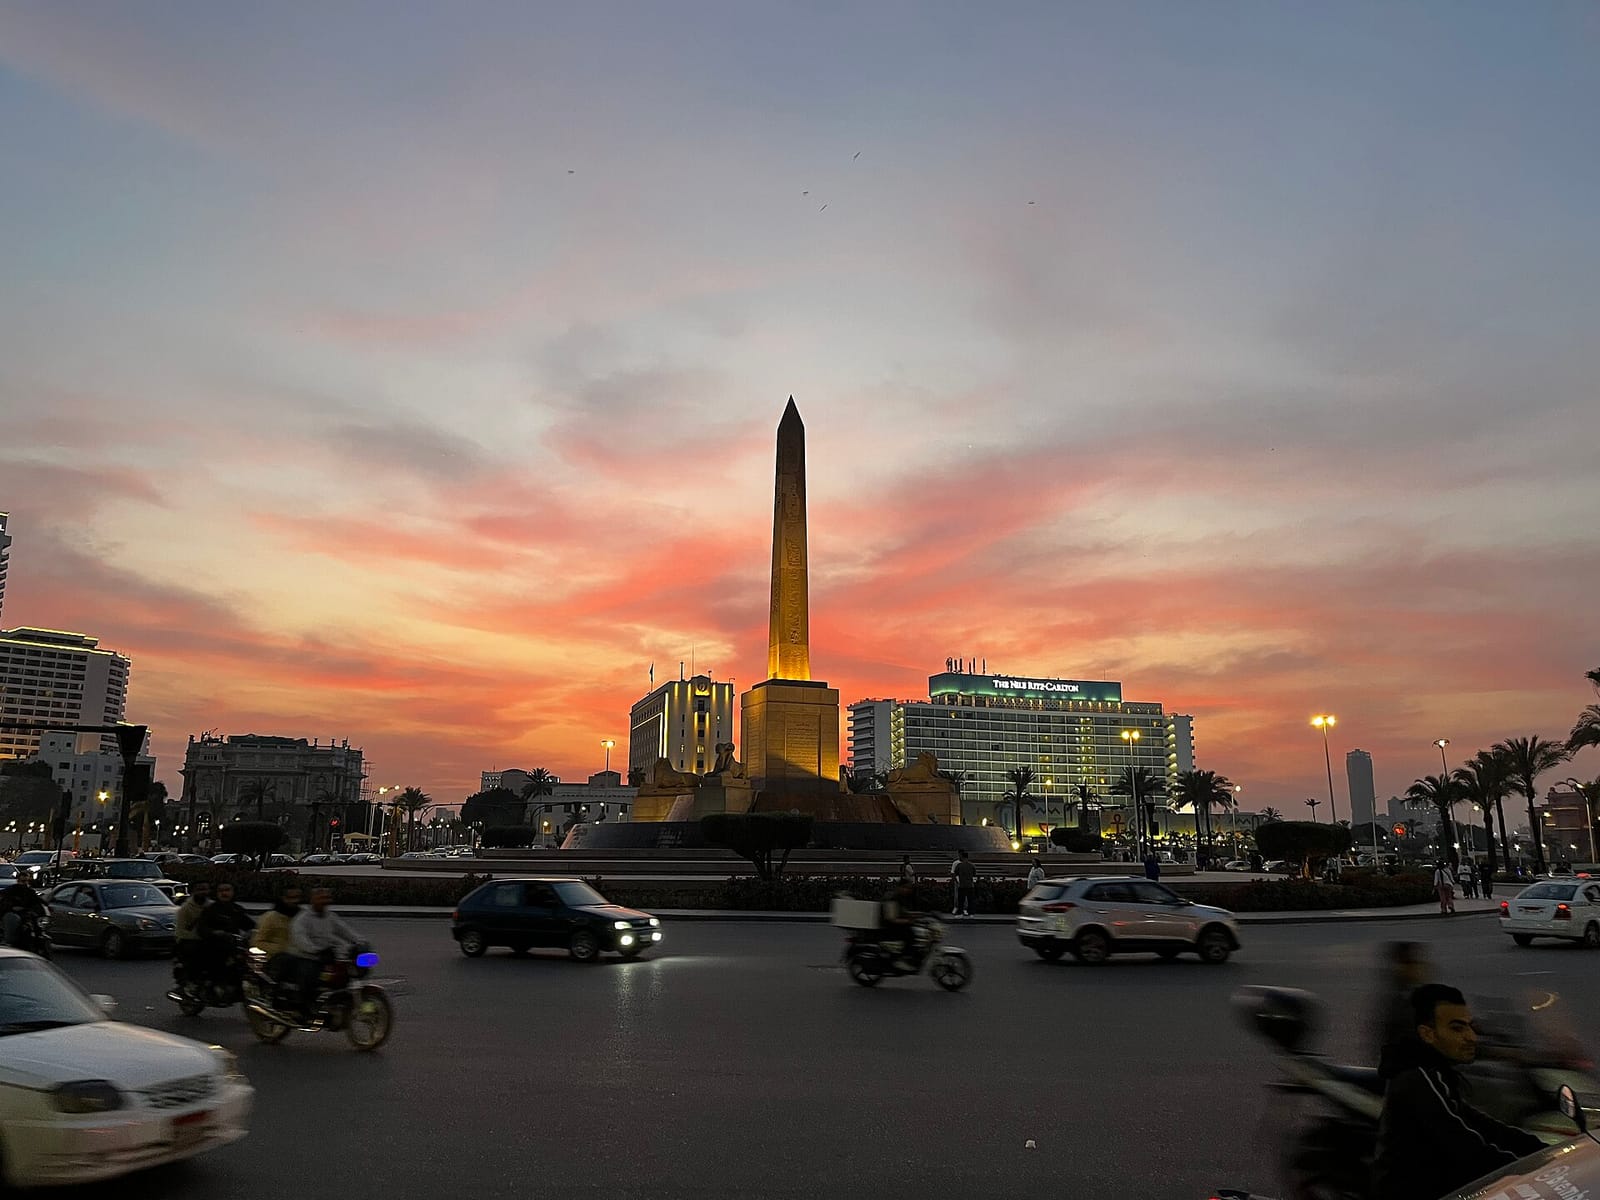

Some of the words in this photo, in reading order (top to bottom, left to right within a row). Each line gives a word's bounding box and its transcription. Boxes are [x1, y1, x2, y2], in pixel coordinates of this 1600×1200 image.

[993, 680, 1009, 688] THE
[1010, 681, 1026, 689] NILE
[1028, 681, 1079, 692] RITZ-CARLTON
